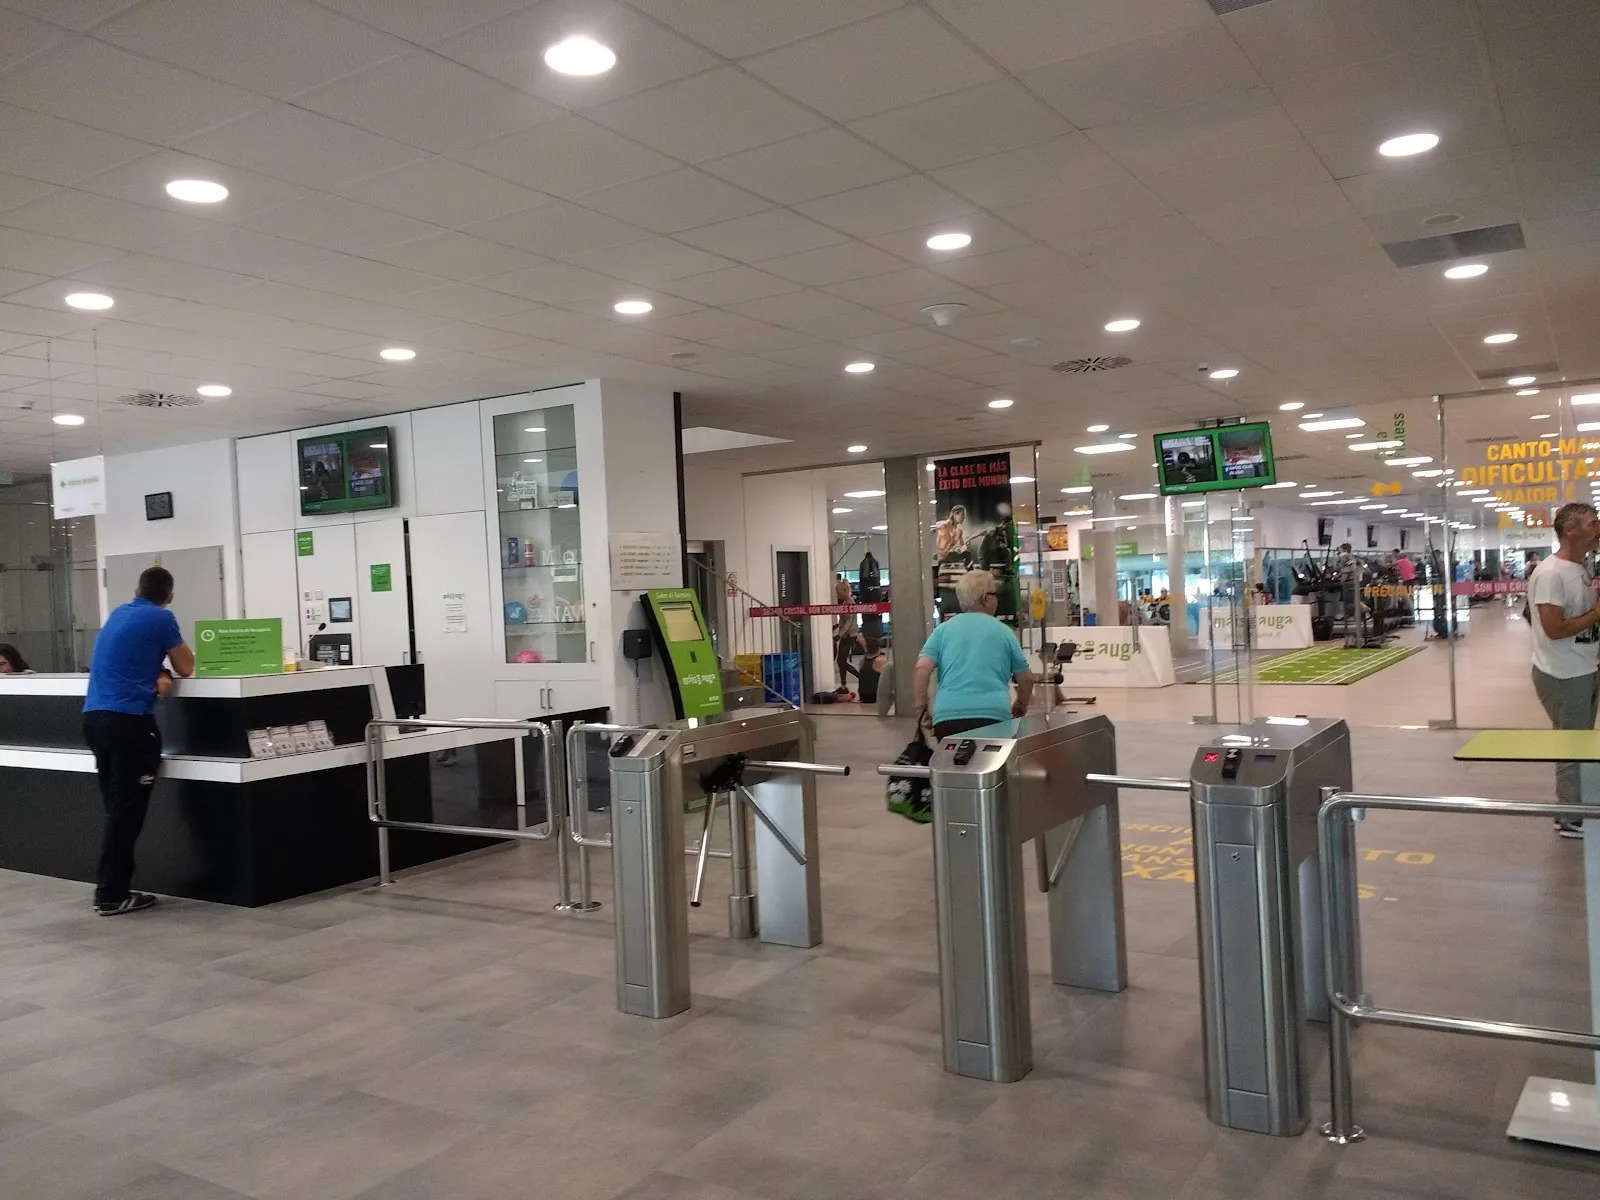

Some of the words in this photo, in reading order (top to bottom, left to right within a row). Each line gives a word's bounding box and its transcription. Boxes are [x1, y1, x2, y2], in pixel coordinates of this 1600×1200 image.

[1486, 440, 1551, 461] CANTO
[938, 467, 949, 477] LA
[950, 464, 975, 476] CLASE
[976, 462, 988, 473] DE
[989, 459, 1008, 473] MÁS
[939, 478, 960, 491] ÉXITO
[962, 477, 977, 488] DEL
[979, 473, 1008, 487] MUNDO
[1495, 487, 1558, 504] MAIOR
[1474, 583, 1492, 593] SON
[1494, 582, 1507, 592] UN
[1259, 615, 1293, 629] auga
[1356, 848, 1435, 864] TO
